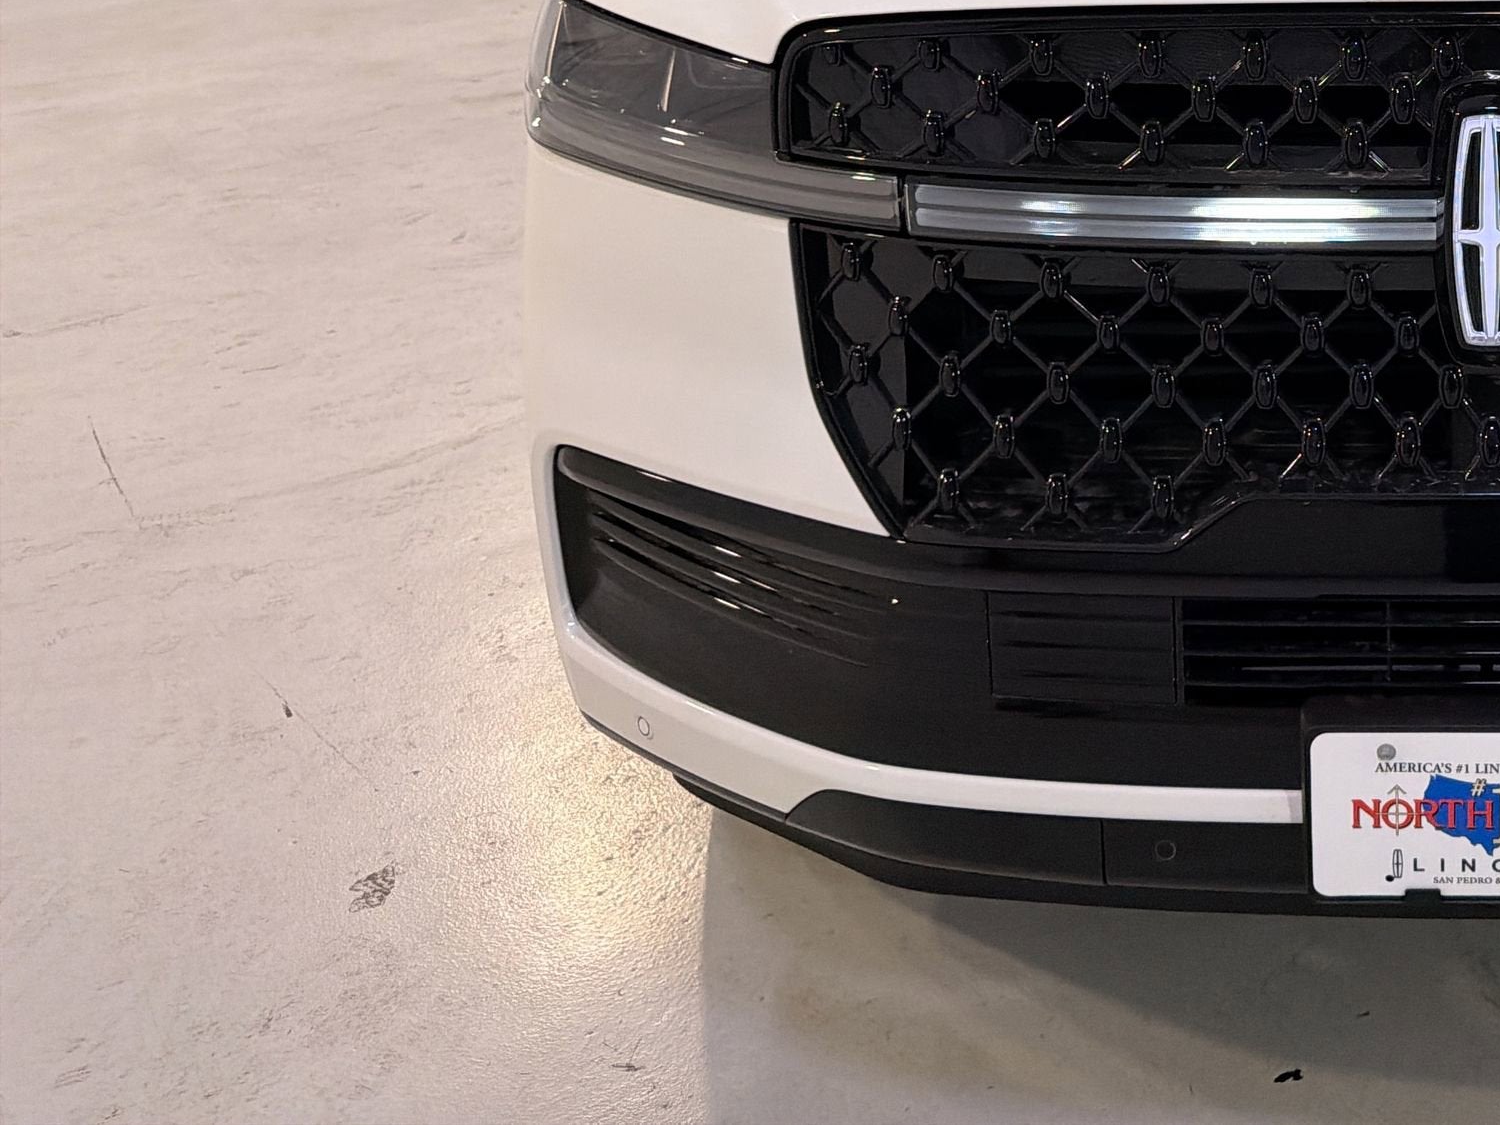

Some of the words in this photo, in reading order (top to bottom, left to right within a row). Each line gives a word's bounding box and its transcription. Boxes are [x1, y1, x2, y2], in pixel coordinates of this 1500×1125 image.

[1375, 762, 1452, 774] AMERICA'S
[1455, 763, 1470, 774] #1
[1351, 798, 1495, 830] NORTH
[1433, 876, 1453, 885] SAN
[1457, 876, 1493, 885] PEDRO
